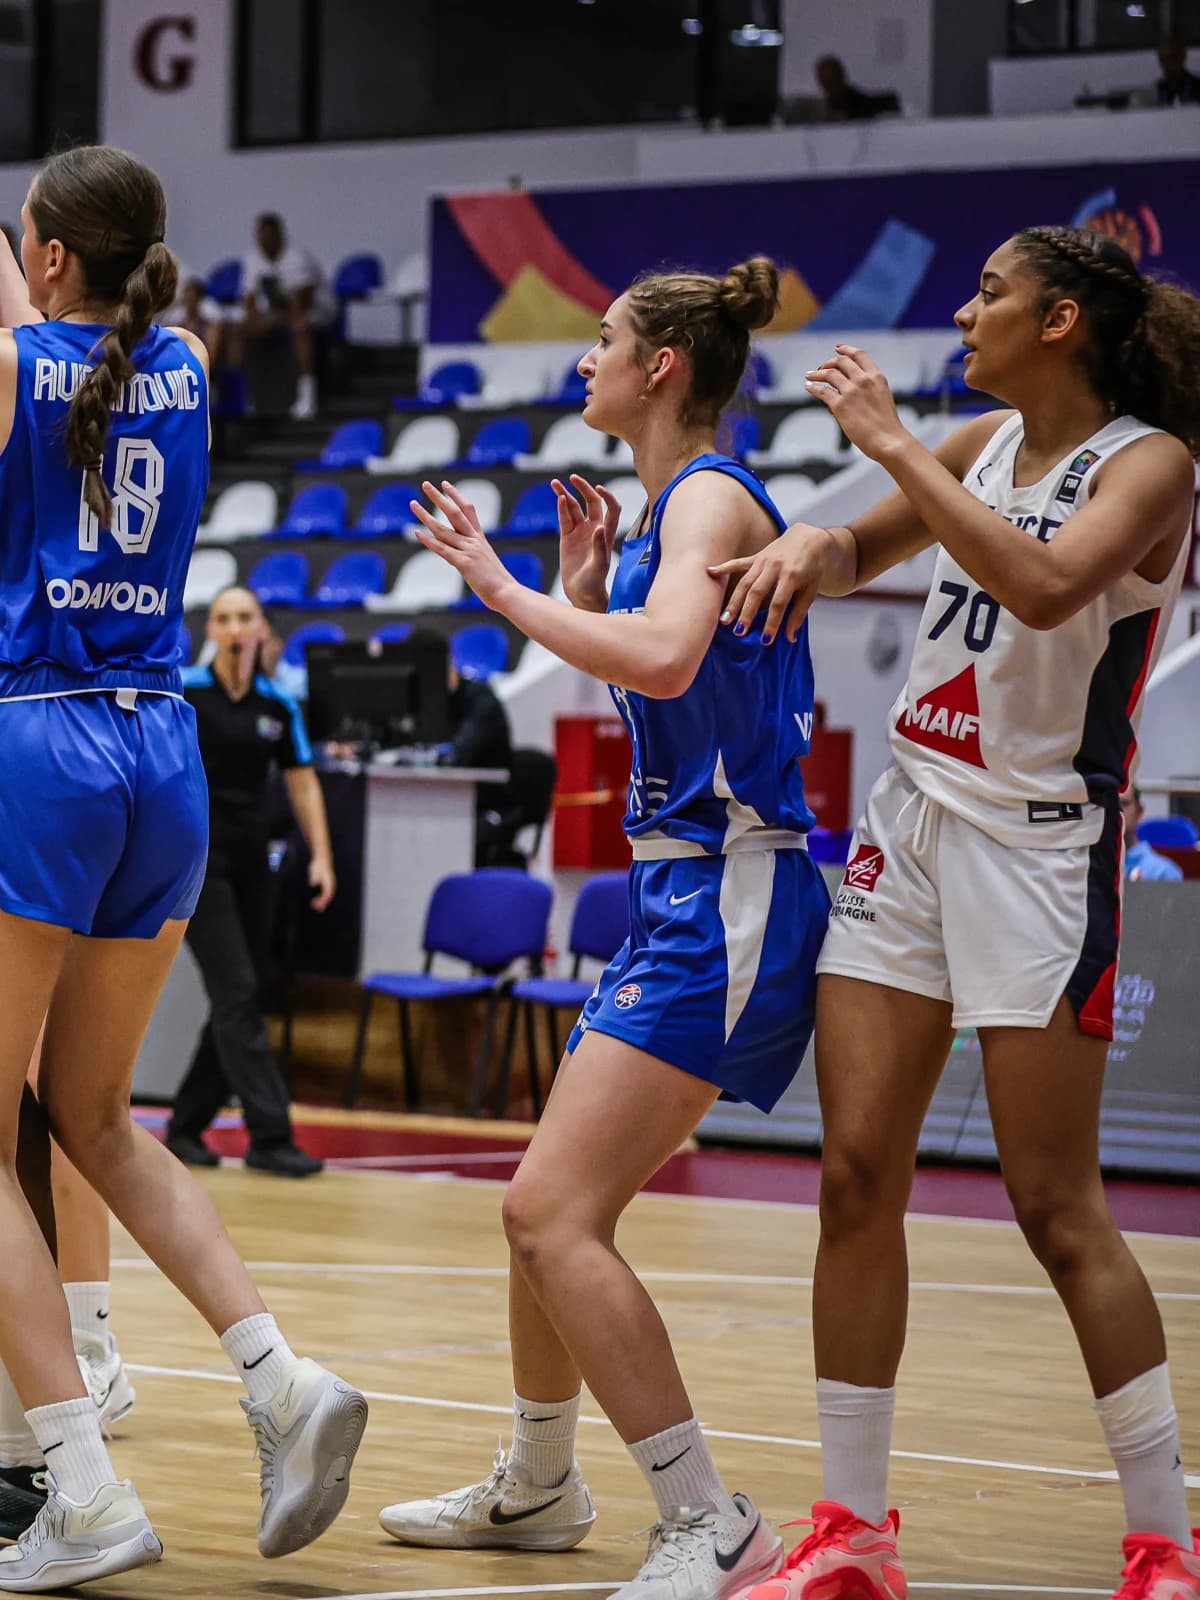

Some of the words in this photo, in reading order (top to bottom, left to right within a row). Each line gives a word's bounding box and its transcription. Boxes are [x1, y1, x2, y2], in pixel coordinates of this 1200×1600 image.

[132, 15, 197, 95] G
[79, 437, 164, 554] 18
[45, 578, 169, 616] ODAVODA
[927, 580, 1000, 653] 70
[904, 702, 982, 741] MAIF
